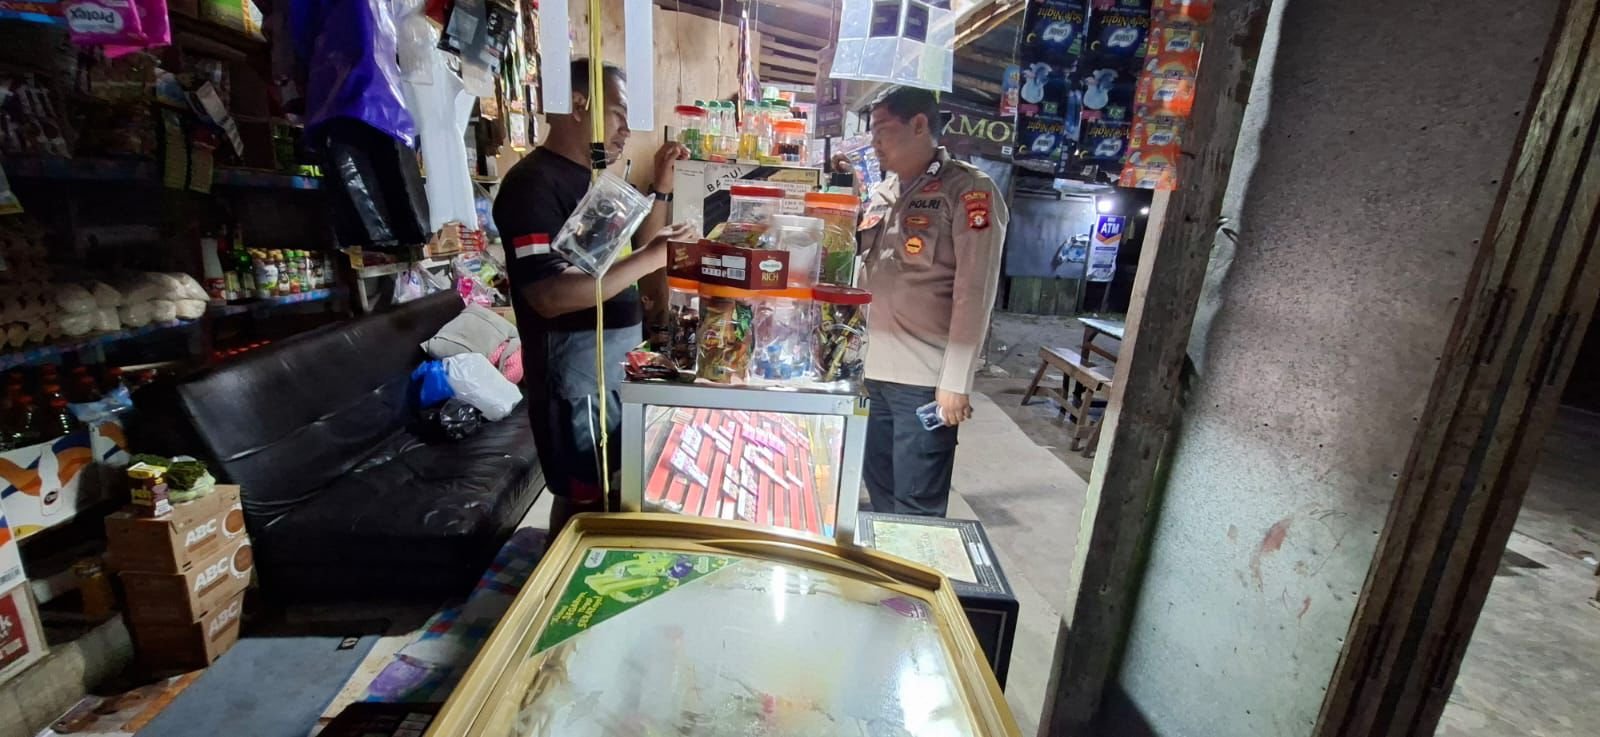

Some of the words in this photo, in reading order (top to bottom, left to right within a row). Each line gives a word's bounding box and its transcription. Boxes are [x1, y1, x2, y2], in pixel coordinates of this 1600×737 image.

[70, 9, 115, 24] Protex
[908, 199, 941, 209] POLRI
[1100, 223, 1121, 234] ATM
[761, 272, 779, 281] RICH
[184, 518, 217, 547] ABC
[194, 556, 229, 593] ABC
[208, 600, 239, 638] ABC
